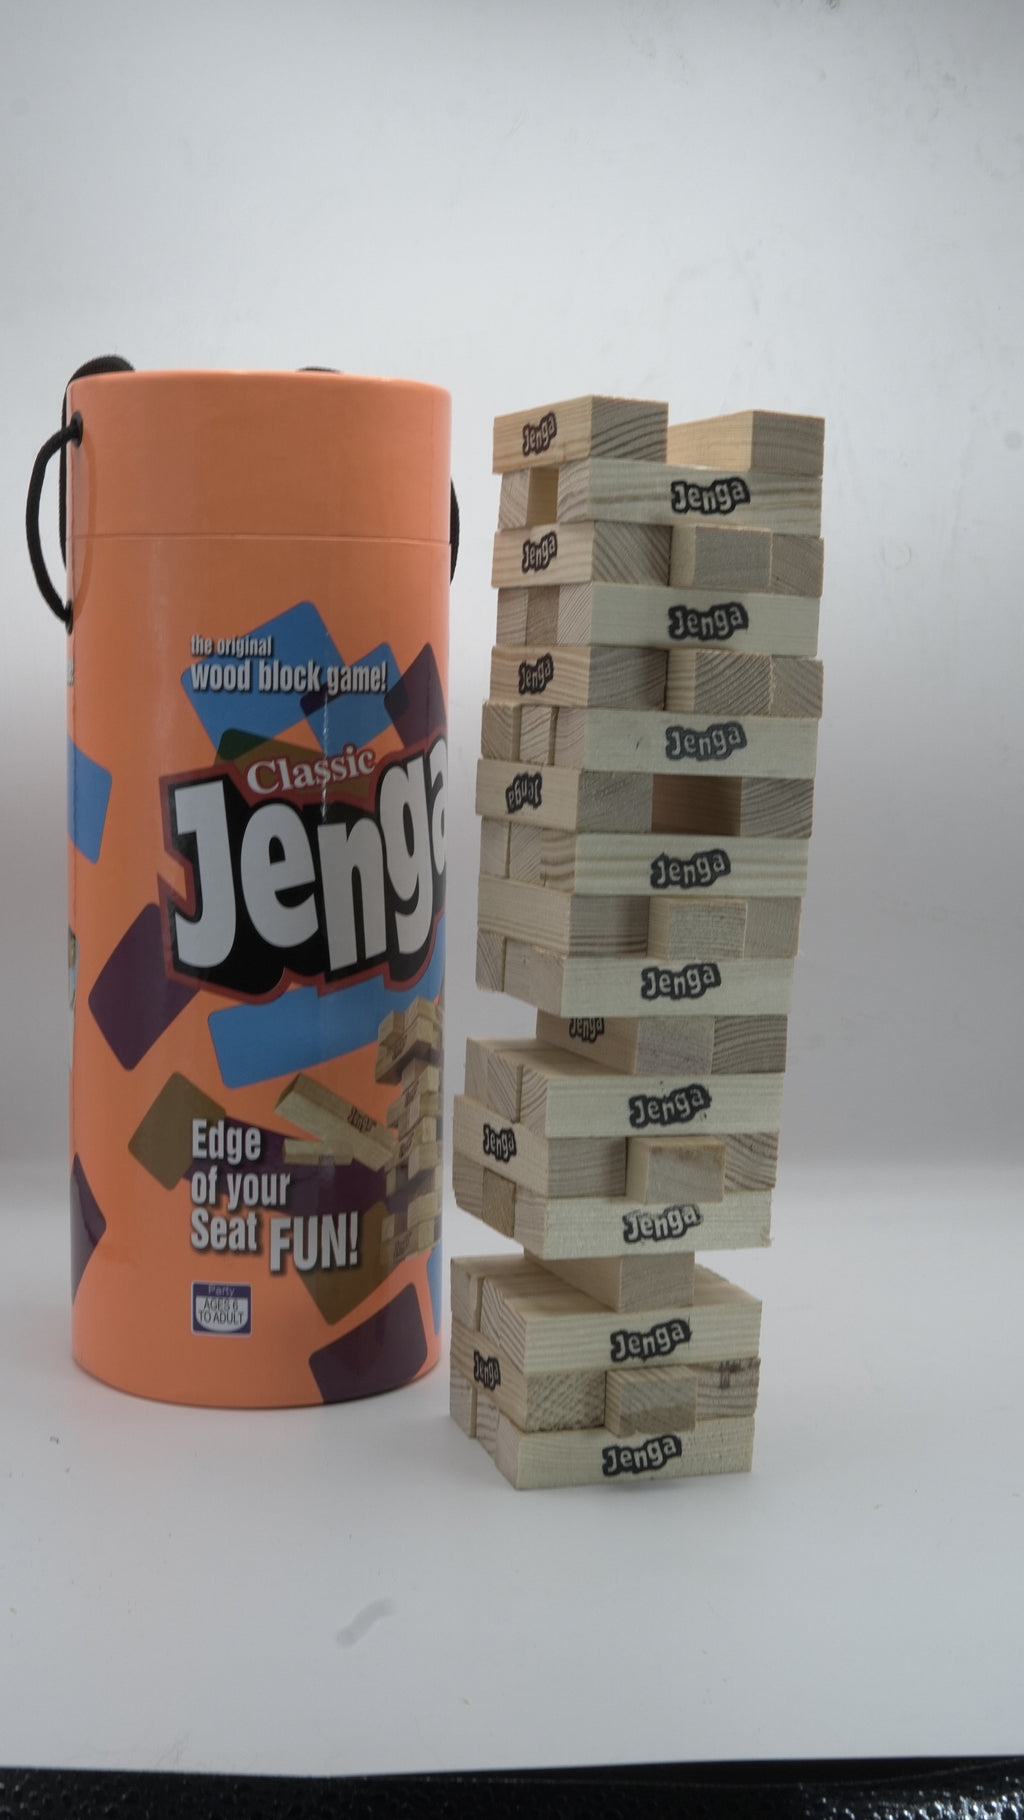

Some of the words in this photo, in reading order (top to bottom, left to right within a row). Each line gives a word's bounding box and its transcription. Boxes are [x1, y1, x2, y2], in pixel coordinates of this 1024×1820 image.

[523, 415, 556, 455] Jenga
[672, 479, 748, 513] Jenga
[523, 534, 556, 572] Jenga
[669, 604, 746, 639] Jenga
[190, 635, 212, 656] the
[217, 635, 272, 658] original
[190, 660, 250, 691] wood
[258, 659, 320, 692] block
[326, 661, 387, 695] game!
[520, 655, 553, 694] Jenga
[668, 723, 745, 759] Jenga
[247, 744, 376, 794] Classic
[507, 776, 541, 811] Jenga
[172, 737, 447, 972] Jenga
[652, 851, 729, 887] Jenga
[643, 964, 719, 998] Jenga
[569, 1017, 604, 1042] Jenga
[631, 1085, 709, 1126] Jenga
[191, 1118, 261, 1165] Edge
[484, 1125, 515, 1161] Jenga
[191, 1165, 218, 1204] of
[226, 1172, 290, 1211] your
[191, 1207, 257, 1251] Seat
[269, 1211, 358, 1272] FUN!
[624, 1205, 699, 1241] Jenga
[199, 1310, 212, 1324] TO
[213, 1311, 244, 1325] ADULT
[203, 1297, 231, 1311] AGES
[612, 1320, 689, 1360] Jenga
[474, 1352, 500, 1389] Jenga
[603, 1436, 679, 1474] Jenga
